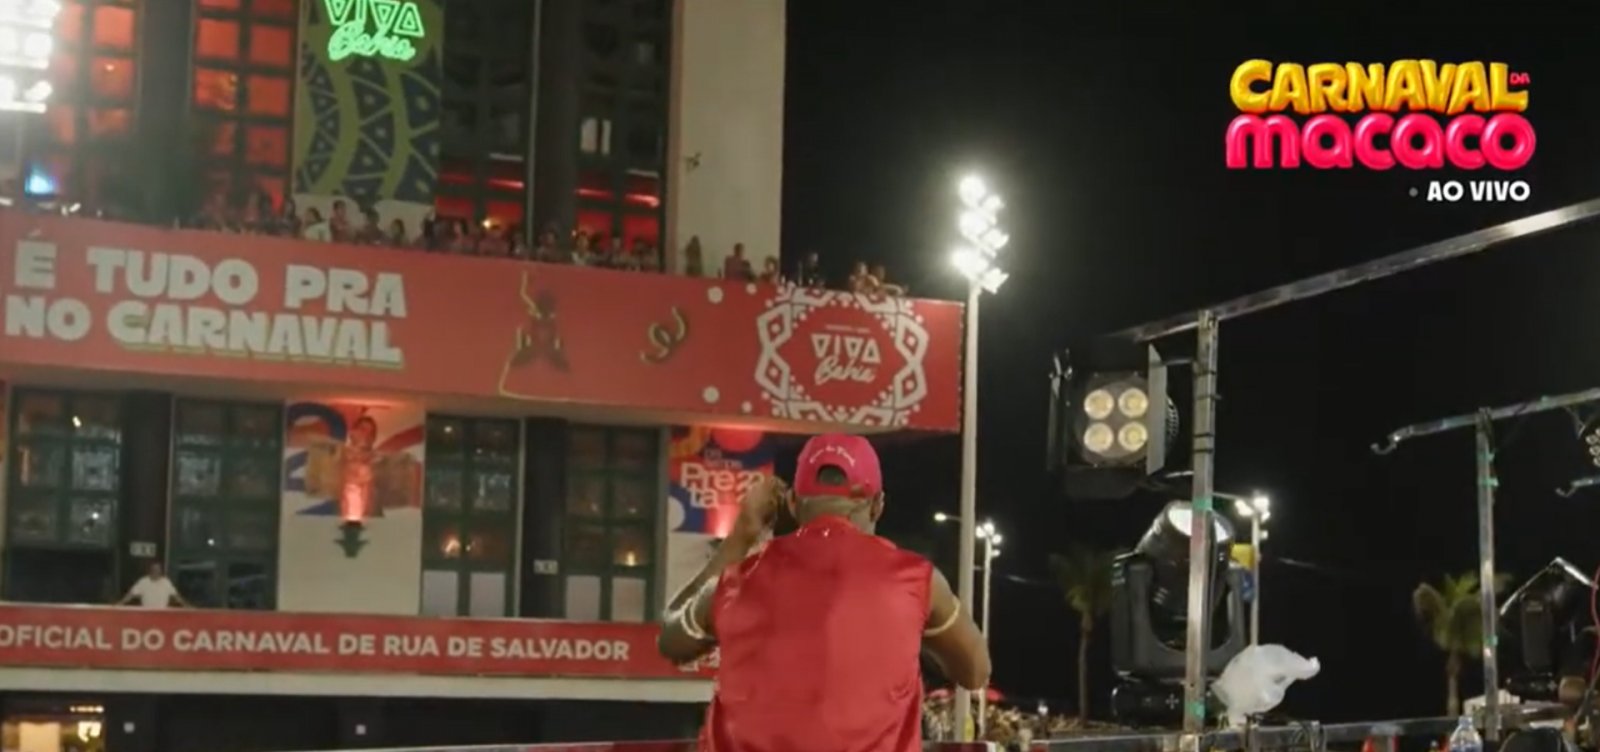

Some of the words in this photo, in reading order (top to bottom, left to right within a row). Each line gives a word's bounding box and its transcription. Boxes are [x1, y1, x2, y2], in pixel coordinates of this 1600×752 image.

[15, 229, 57, 289] É
[87, 246, 259, 306] TUDO
[284, 264, 407, 317] PRA
[5, 295, 91, 341] NO
[107, 301, 403, 366] CARNAVAL
[811, 333, 881, 364] VIVA
[0, 624, 111, 650] OFICIAL
[121, 628, 164, 650] DO
[172, 629, 330, 655] CARNAVAL
[338, 634, 375, 656] DE
[383, 635, 439, 657] RUA
[447, 637, 483, 658] DE
[490, 638, 630, 662] SALVADOR
